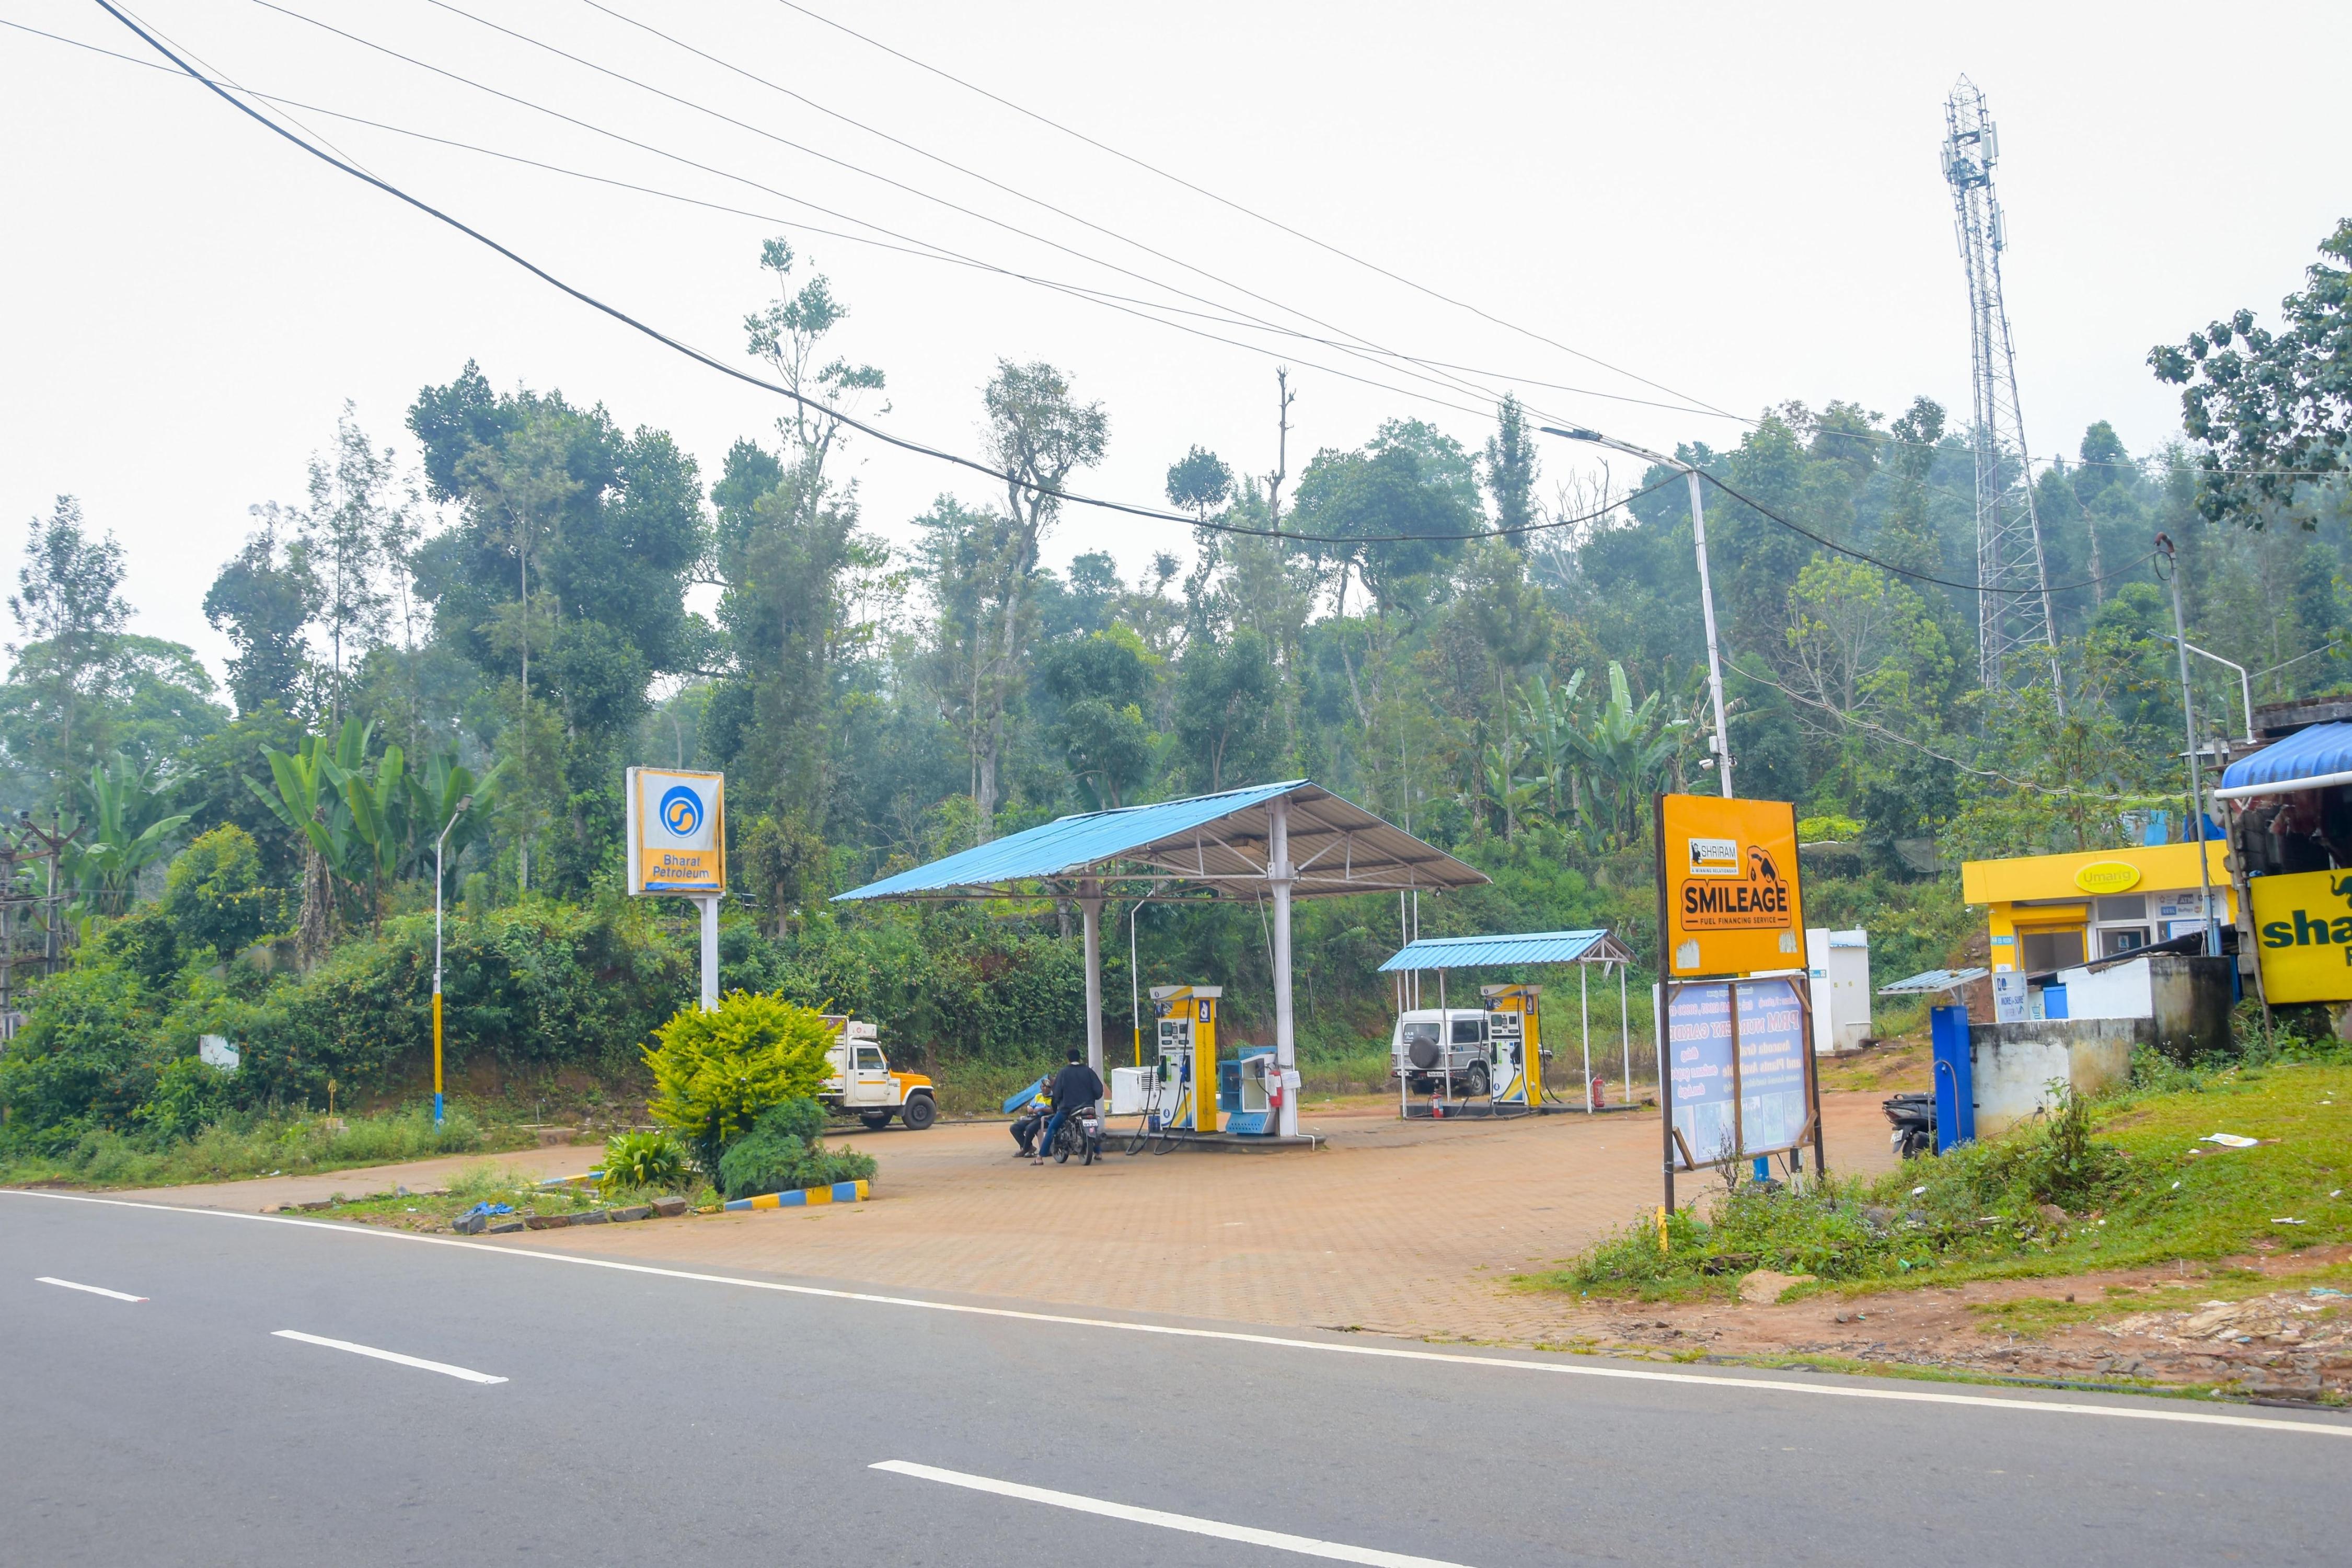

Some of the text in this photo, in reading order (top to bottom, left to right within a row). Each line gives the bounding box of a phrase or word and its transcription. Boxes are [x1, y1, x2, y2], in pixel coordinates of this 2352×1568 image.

[1701, 845, 1736, 858] SHRIRAM
[664, 854, 700, 867] Bharat
[653, 866, 709, 878] Petroleum
[1685, 886, 1788, 914] SMILEAGE
